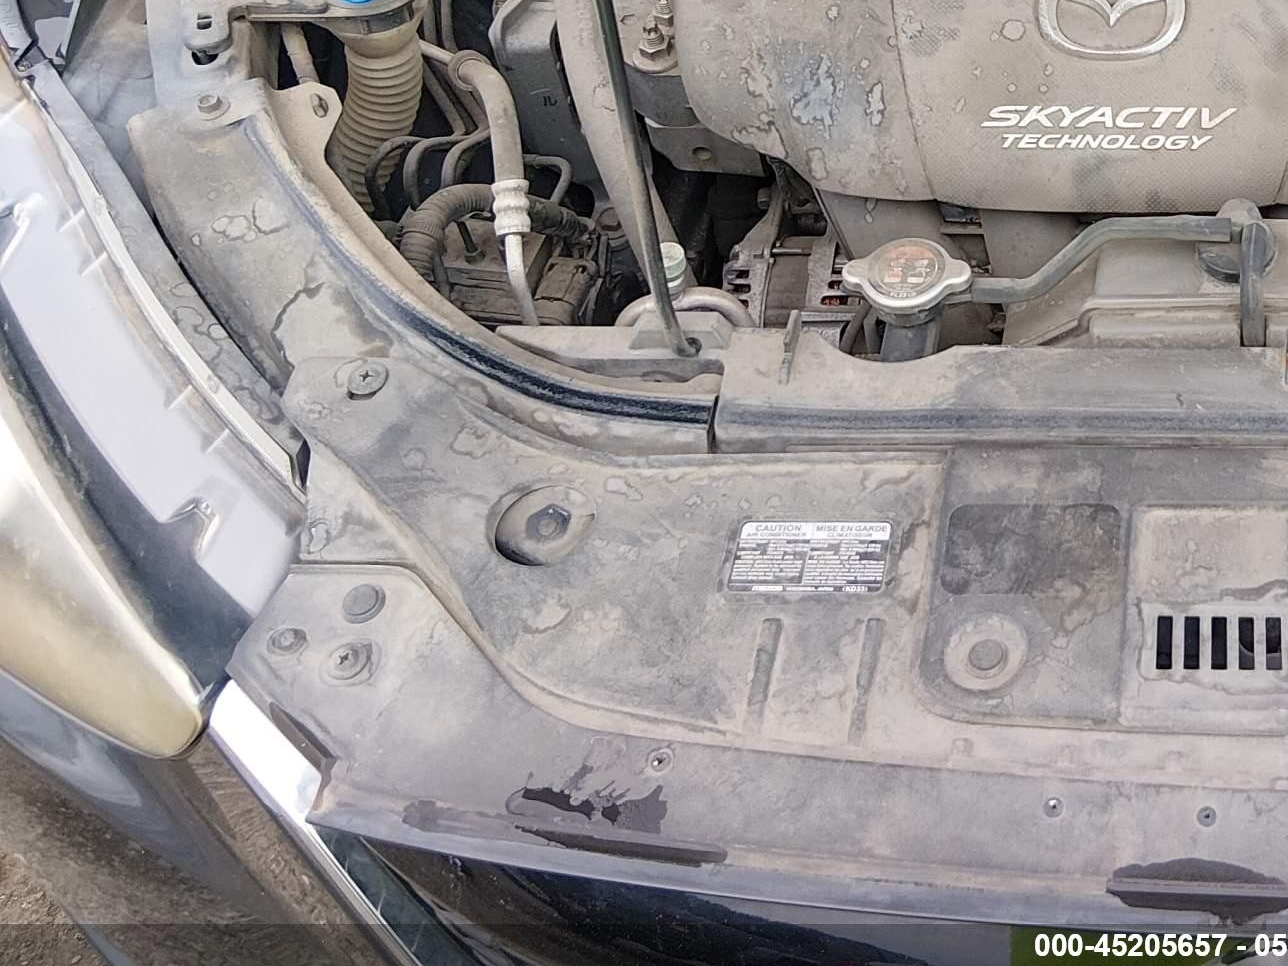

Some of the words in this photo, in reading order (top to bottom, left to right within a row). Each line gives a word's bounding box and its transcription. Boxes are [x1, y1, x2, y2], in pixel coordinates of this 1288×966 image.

[980, 105, 1239, 129] SKYACTIV
[1001, 134, 1213, 151] TECHNOLOGY
[755, 524, 802, 532] CAUTION
